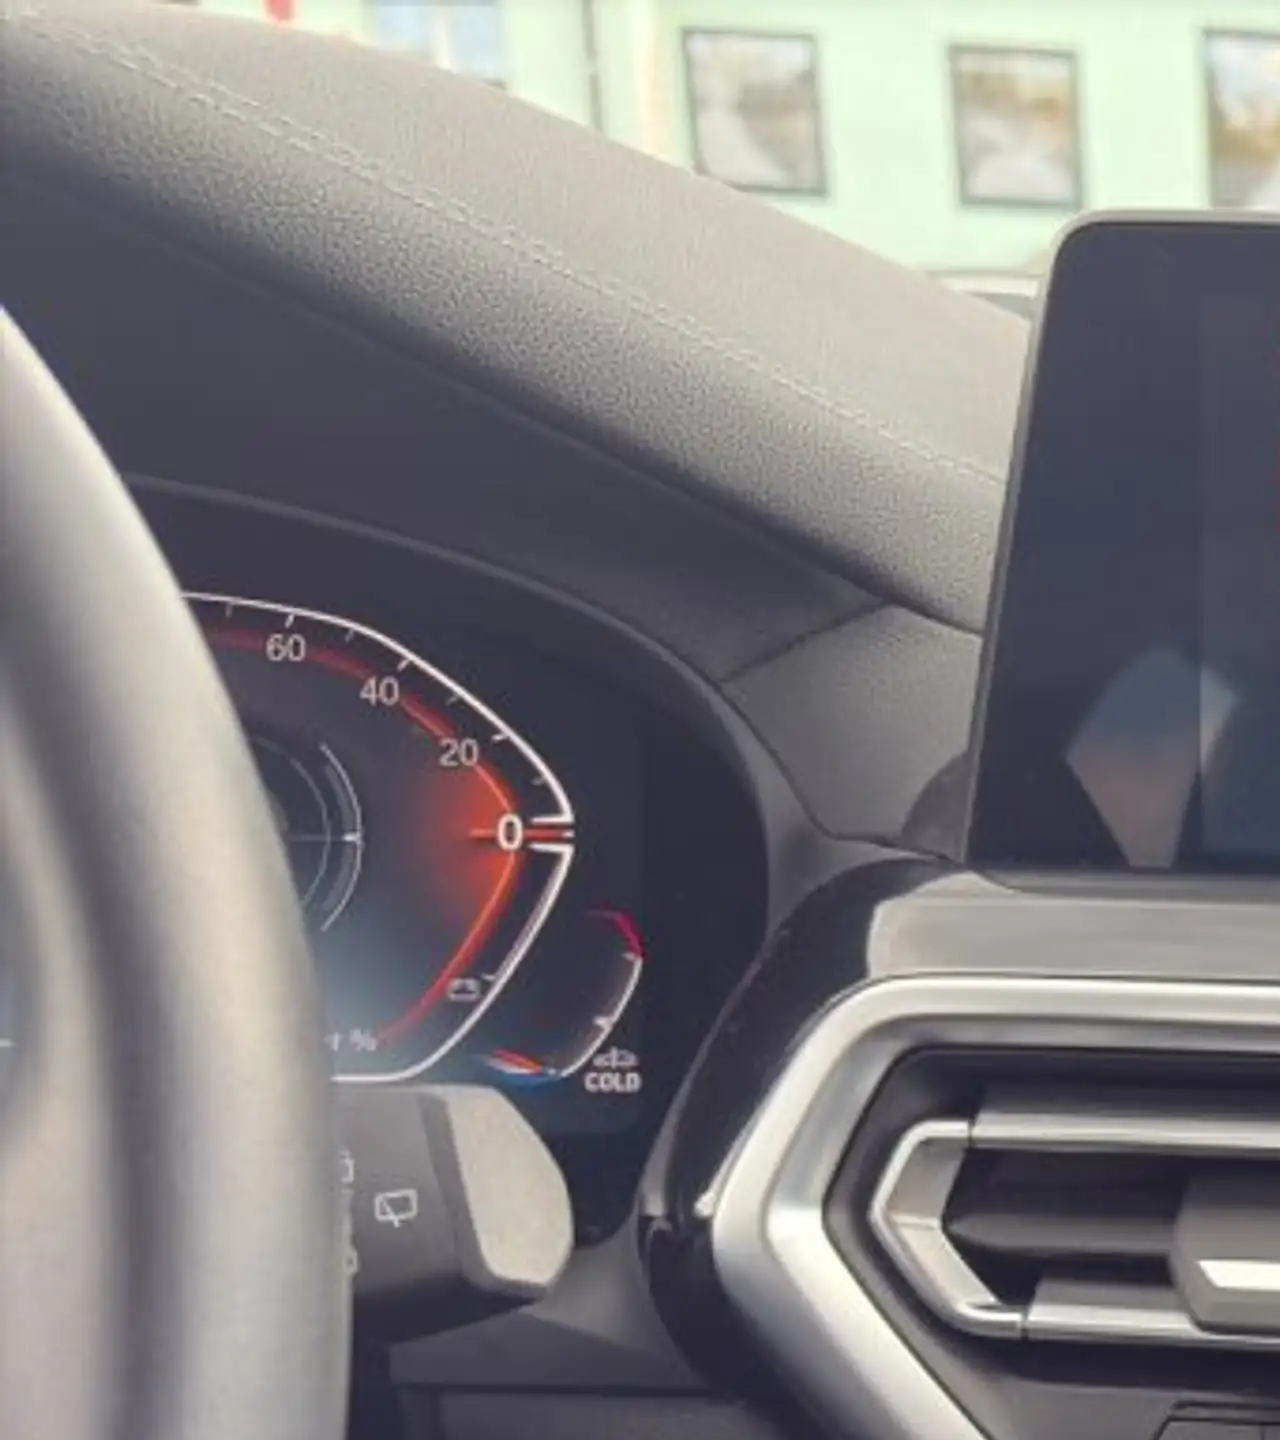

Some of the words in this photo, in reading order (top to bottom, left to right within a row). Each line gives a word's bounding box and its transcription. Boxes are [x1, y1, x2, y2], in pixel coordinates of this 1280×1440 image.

[265, 632, 306, 662] 60
[359, 676, 400, 706] 40
[438, 739, 479, 767] 20
[497, 813, 524, 852] 0
[584, 1072, 641, 1093] COLD
